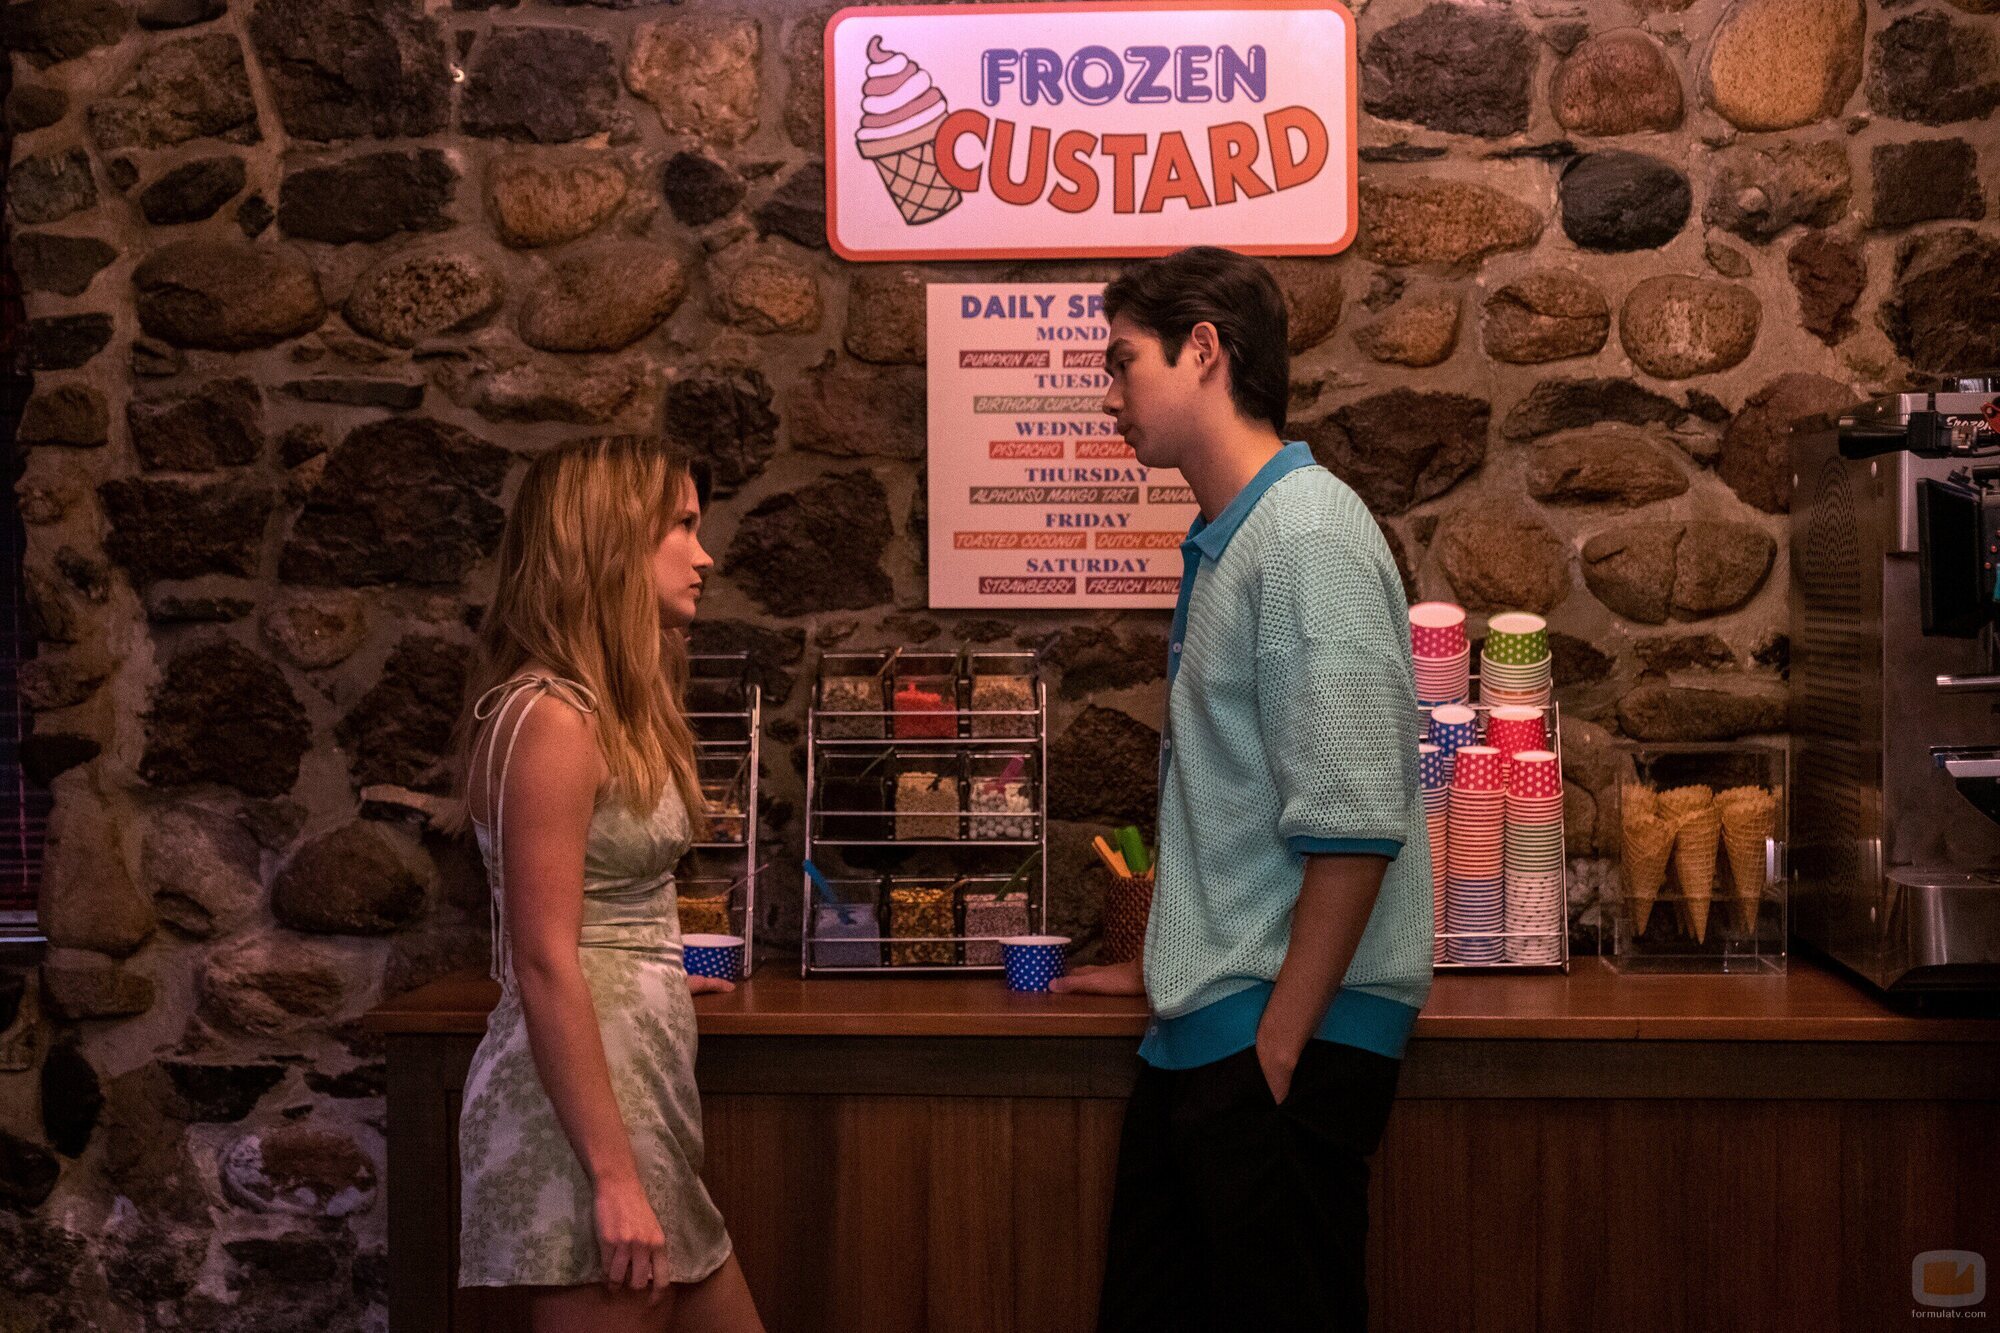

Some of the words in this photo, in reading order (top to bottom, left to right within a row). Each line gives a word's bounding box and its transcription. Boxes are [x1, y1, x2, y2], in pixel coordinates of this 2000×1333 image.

[981, 45, 1266, 106] FROZEN
[934, 105, 1329, 214] CUSTARD
[961, 295, 1056, 319] DAILY
[962, 352, 1024, 367] PUMPKIN
[1024, 352, 1047, 367] PIE
[976, 397, 1042, 412] BIRTHDAY
[991, 442, 1061, 457] PISTACHIO
[1025, 467, 1150, 482] THURSDAY
[972, 488, 1045, 503] ALPHONSO
[1047, 488, 1098, 503] MANGO
[1101, 488, 1136, 503] TART
[1046, 512, 1130, 528] FRIDAY
[956, 533, 1019, 548] TOASTED
[1020, 533, 1083, 548] COCONUT
[1097, 533, 1143, 548] DUTCH
[1026, 557, 1150, 573] SATURDAY
[982, 578, 1075, 593] STRAWBERRY
[1087, 578, 1144, 593] FRENCH
